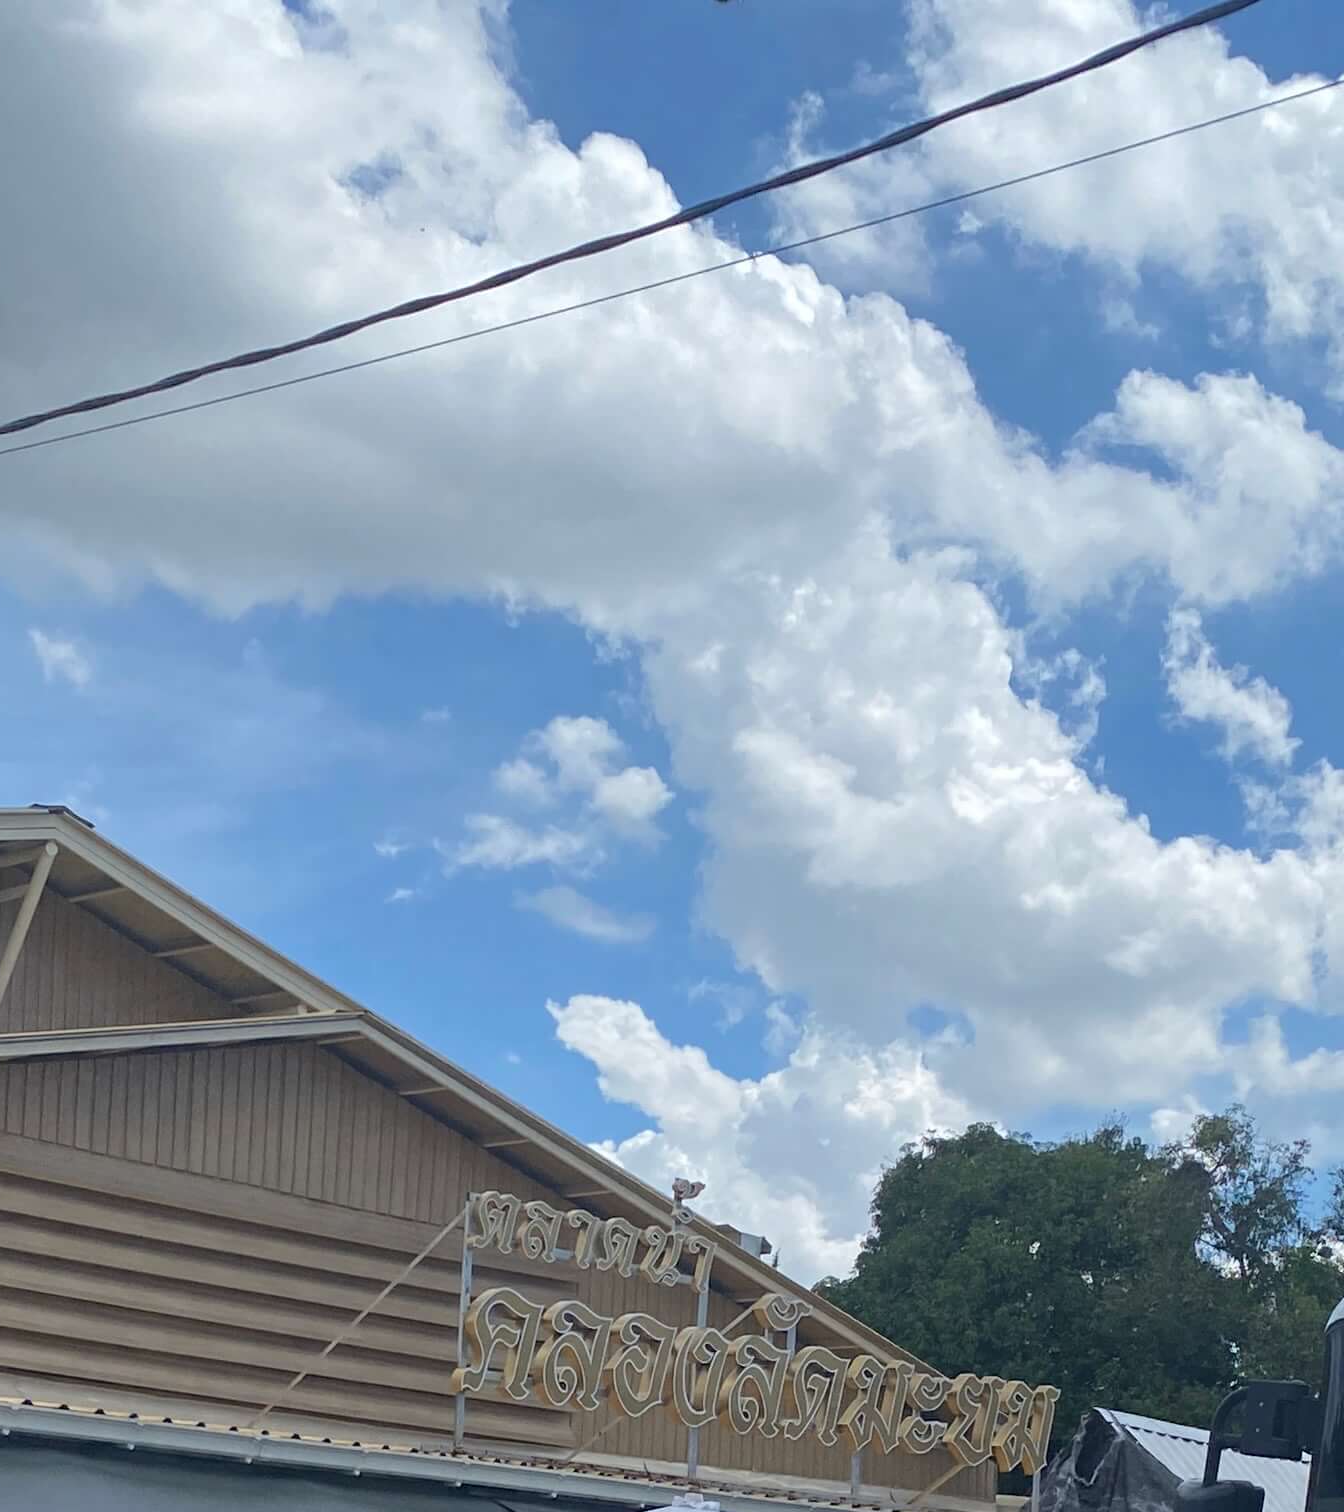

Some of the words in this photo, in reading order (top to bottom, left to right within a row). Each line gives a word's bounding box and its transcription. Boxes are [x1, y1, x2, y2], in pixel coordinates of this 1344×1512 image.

[464, 1177, 718, 1296] ตลาดน้ำ
[453, 1288, 1060, 1476] คลองลัดมะยม
